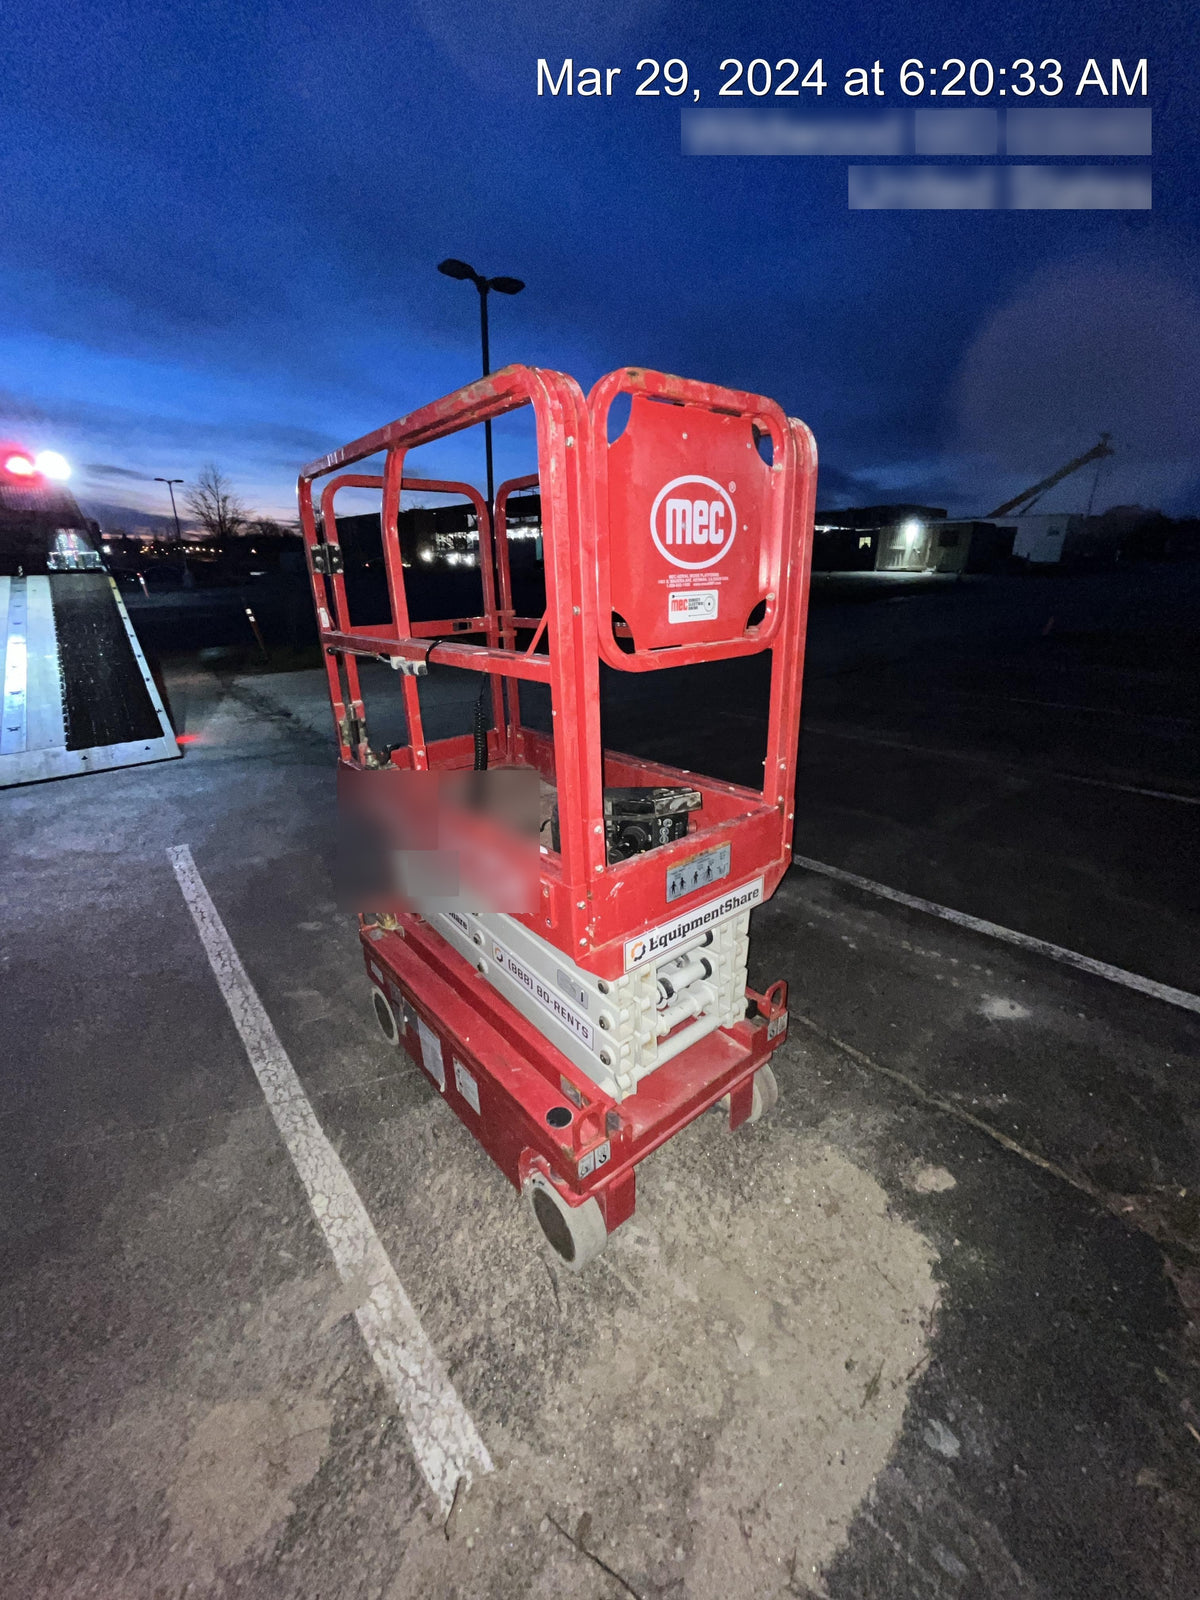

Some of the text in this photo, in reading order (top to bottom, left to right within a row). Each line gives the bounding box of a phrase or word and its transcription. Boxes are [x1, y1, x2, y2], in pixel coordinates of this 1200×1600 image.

[649, 888, 760, 950] EquipmentShare
[507, 957, 589, 1039] (888) 80-RENTS
